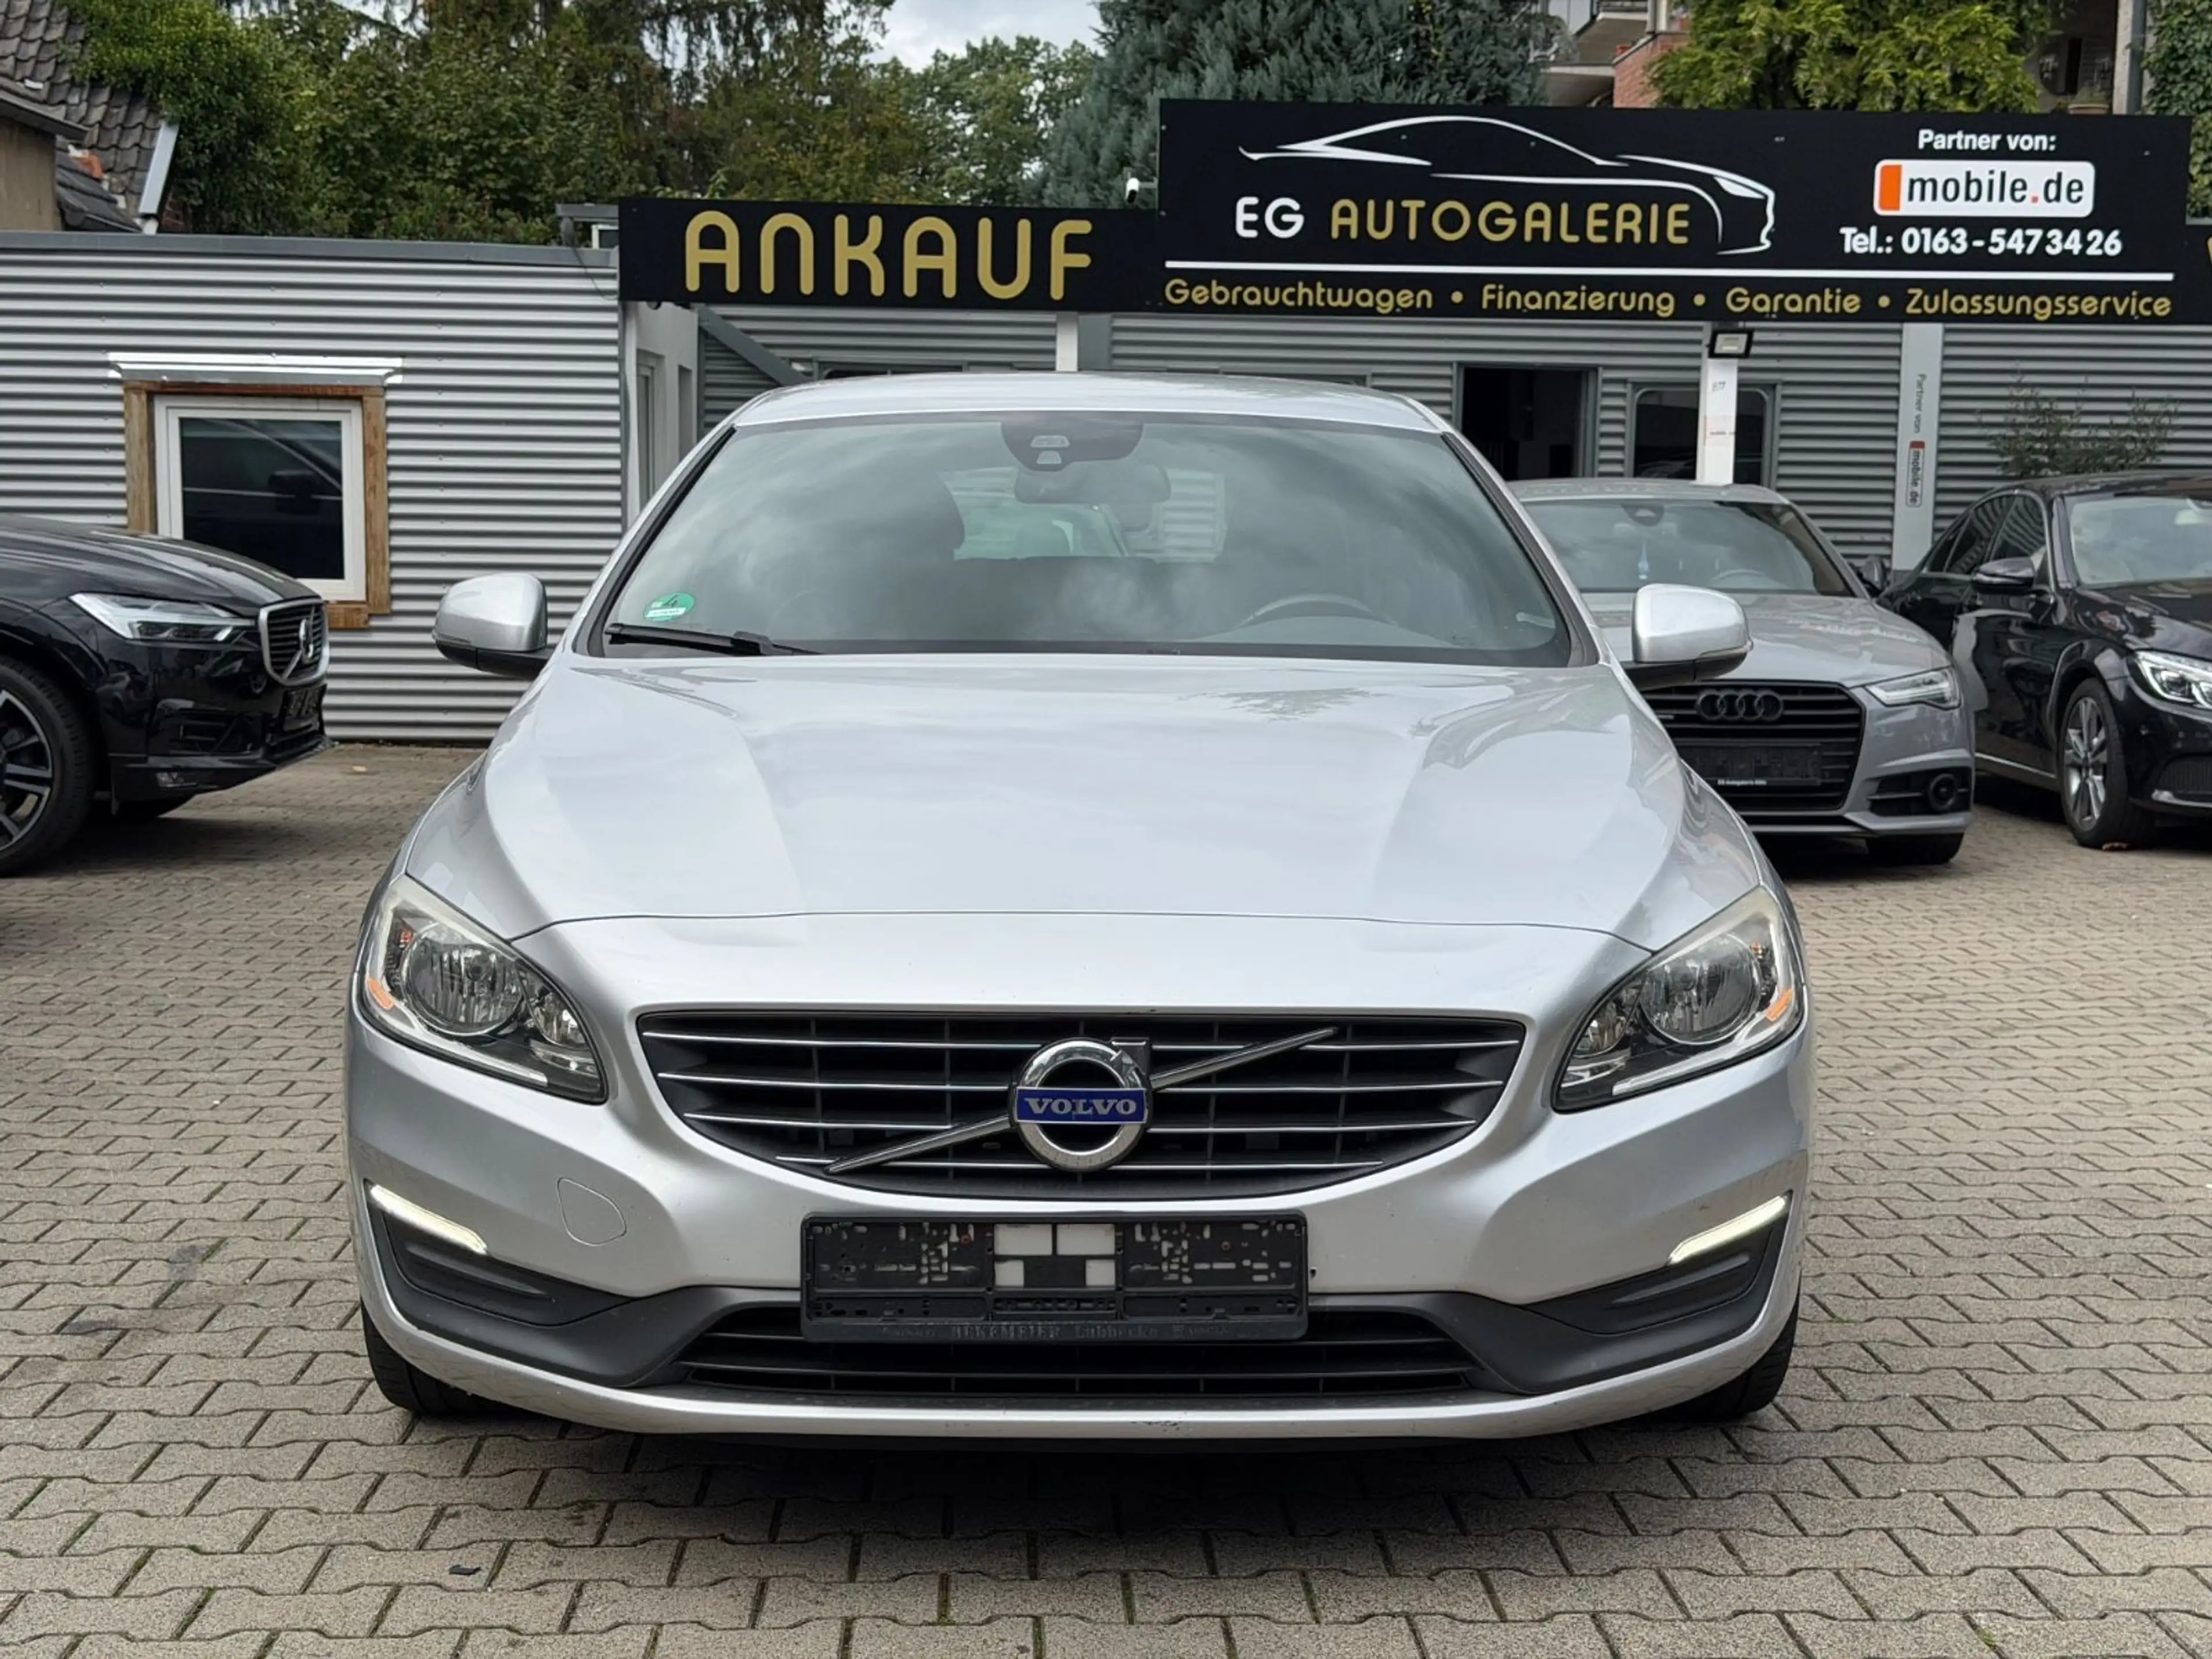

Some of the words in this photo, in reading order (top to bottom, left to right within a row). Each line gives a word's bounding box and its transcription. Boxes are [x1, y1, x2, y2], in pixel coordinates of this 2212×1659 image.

[1918, 128, 2002, 151] Partner
[2006, 134, 2056, 151] von:
[1907, 169, 2084, 203] mobile.de
[1235, 196, 1305, 239] EG
[1330, 198, 1691, 245] AUTOGALERIE
[684, 210, 1093, 301] ANKAUF
[1839, 225, 1893, 254] Tel.:
[1164, 278, 1433, 315] Gebrauchtwagen
[1481, 283, 1676, 317] Finanzierung
[1725, 287, 1861, 314] Garantie
[1905, 287, 2172, 321] Zulassungsservice
[1024, 1097, 1137, 1115] VOLVO
